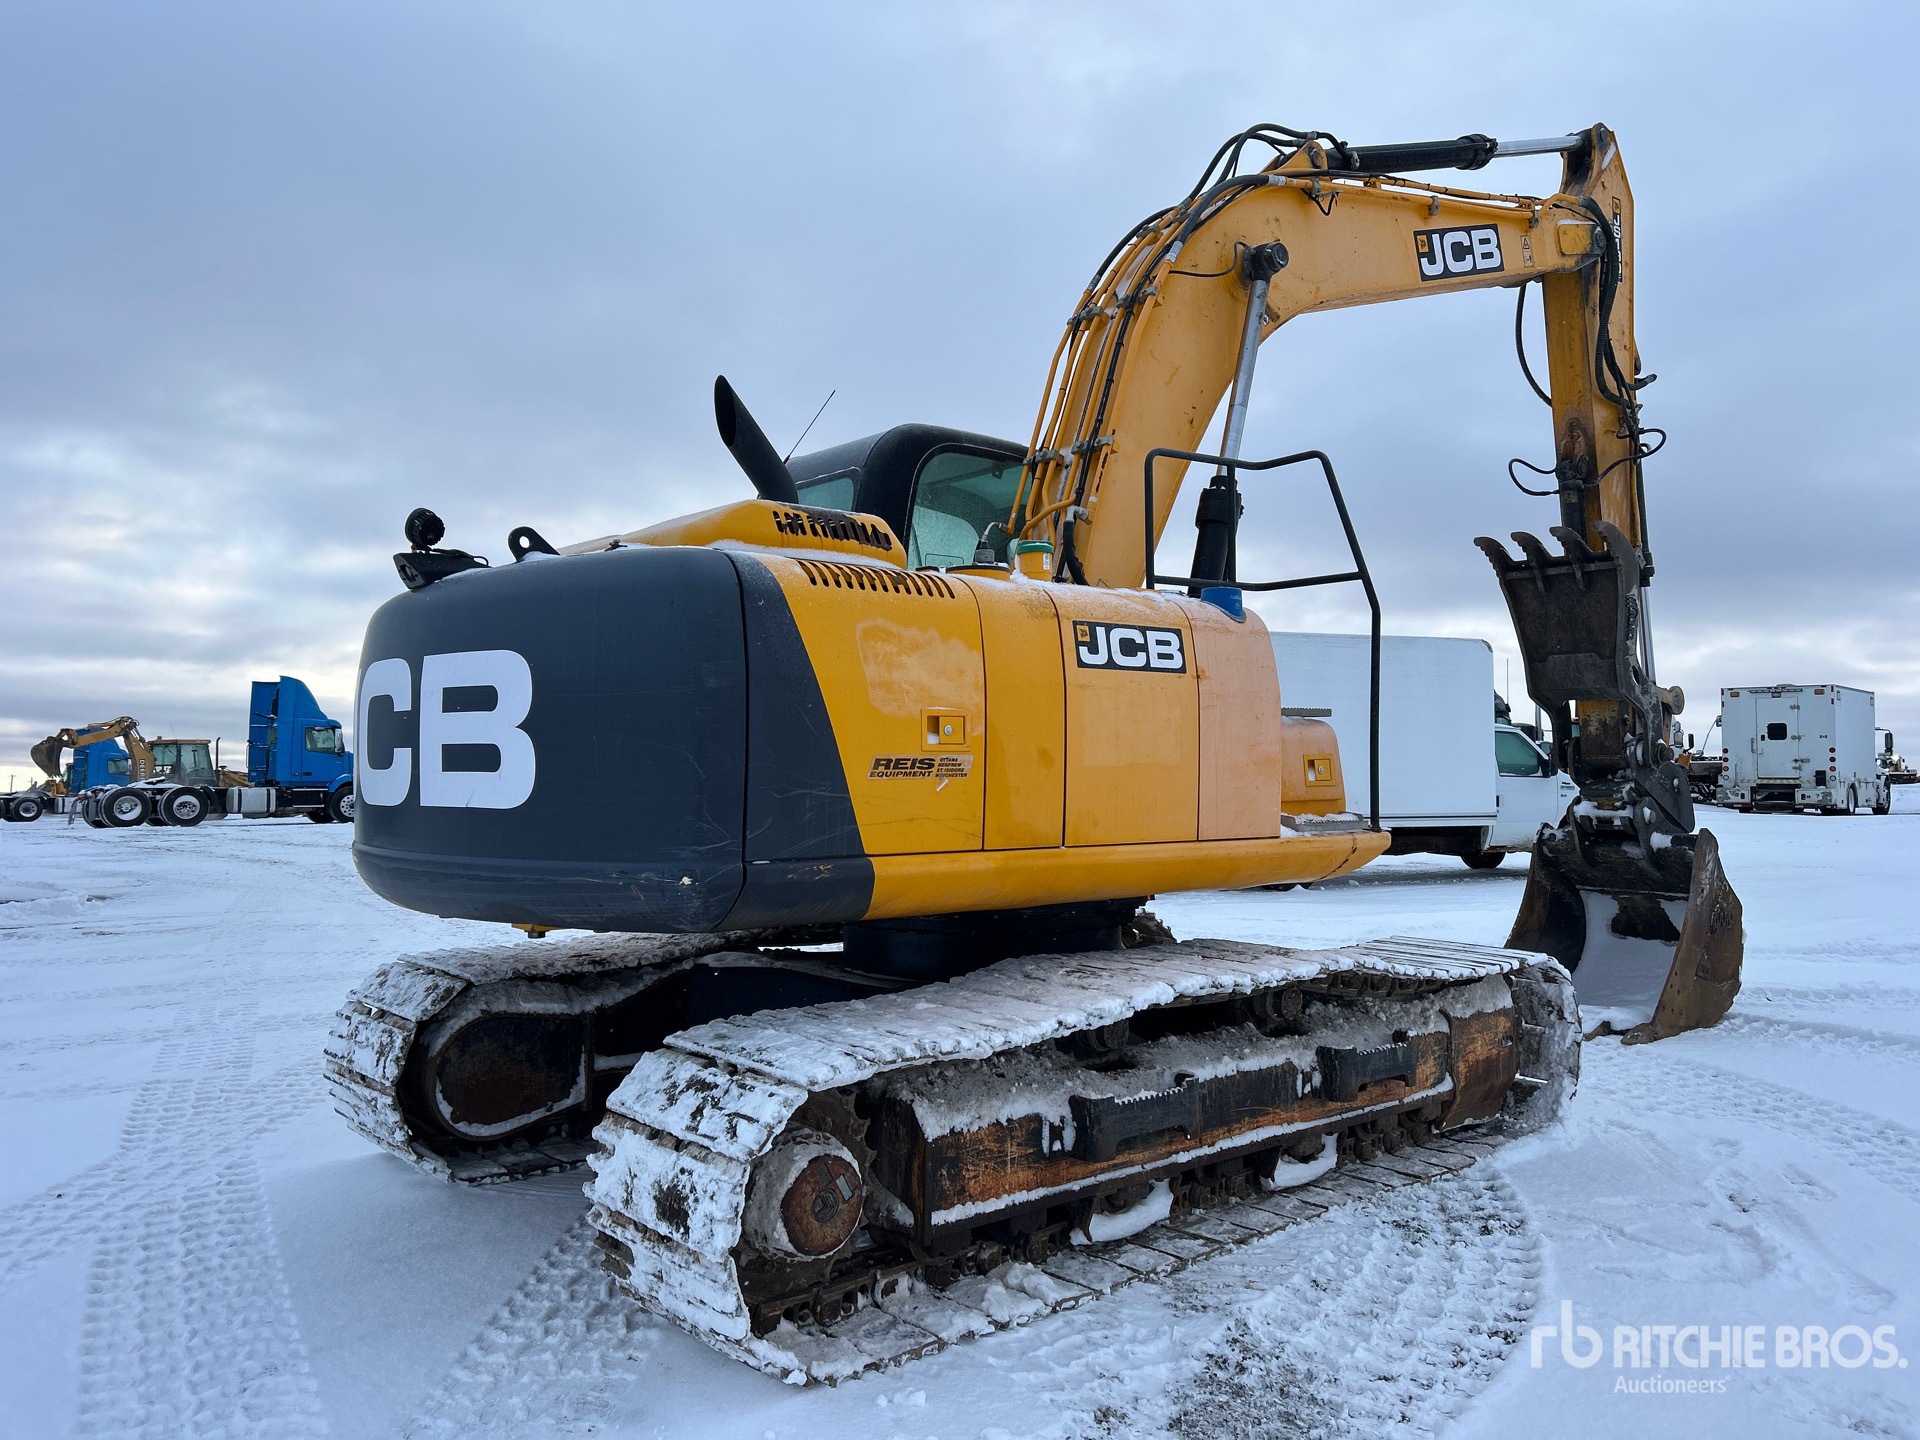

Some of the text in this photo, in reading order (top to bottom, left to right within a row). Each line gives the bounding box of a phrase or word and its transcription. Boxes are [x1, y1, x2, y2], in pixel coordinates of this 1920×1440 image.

[1420, 228, 1501, 276] JCB
[1079, 626, 1183, 669] JCB
[353, 649, 536, 810] CB
[869, 770, 933, 779] EQUIPMENT
[872, 757, 936, 770] REIS
